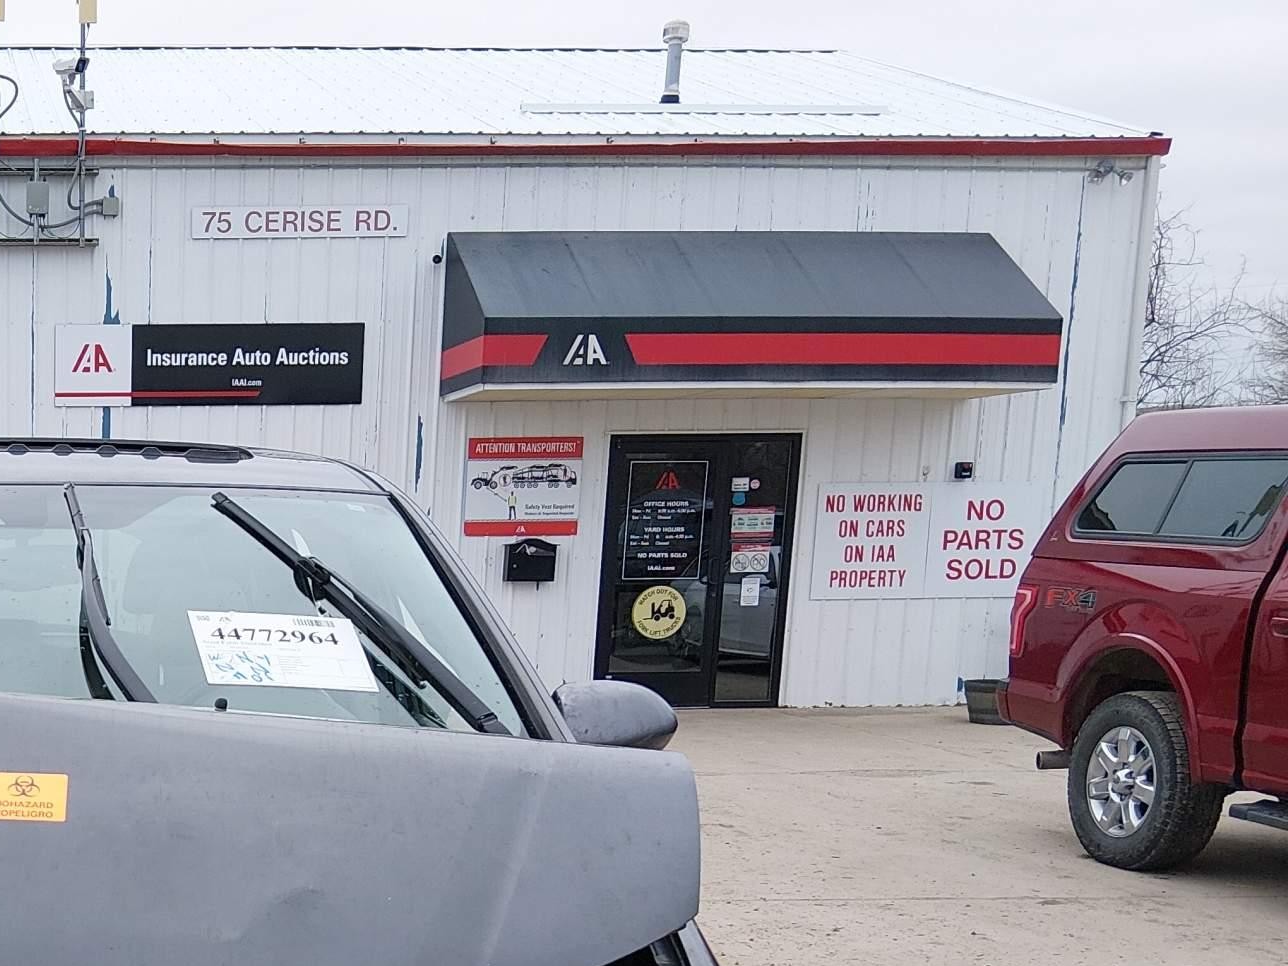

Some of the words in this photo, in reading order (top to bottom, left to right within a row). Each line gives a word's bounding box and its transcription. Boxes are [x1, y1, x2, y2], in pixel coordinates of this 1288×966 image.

[202, 211, 232, 234] 75
[244, 210, 342, 233] CERISE
[355, 210, 398, 232] RD.
[146, 348, 227, 367] Insurance
[232, 348, 271, 366] Auto
[275, 347, 349, 366] Auctions
[475, 442, 515, 454] ATTENTION
[517, 441, 576, 453] TRANSPORTERS!
[825, 495, 846, 513] NO
[853, 494, 923, 512] WORKING
[966, 499, 1005, 521] NO
[838, 520, 859, 538] ON
[866, 519, 906, 538] CARS
[942, 528, 1024, 551] PARTS
[843, 545, 863, 563] ON
[871, 544, 896, 563] IAA
[829, 569, 906, 588] PROPERTY
[945, 558, 1017, 581] SOLD
[1046, 586, 1096, 608] FX4
[211, 627, 340, 646] 44772964
